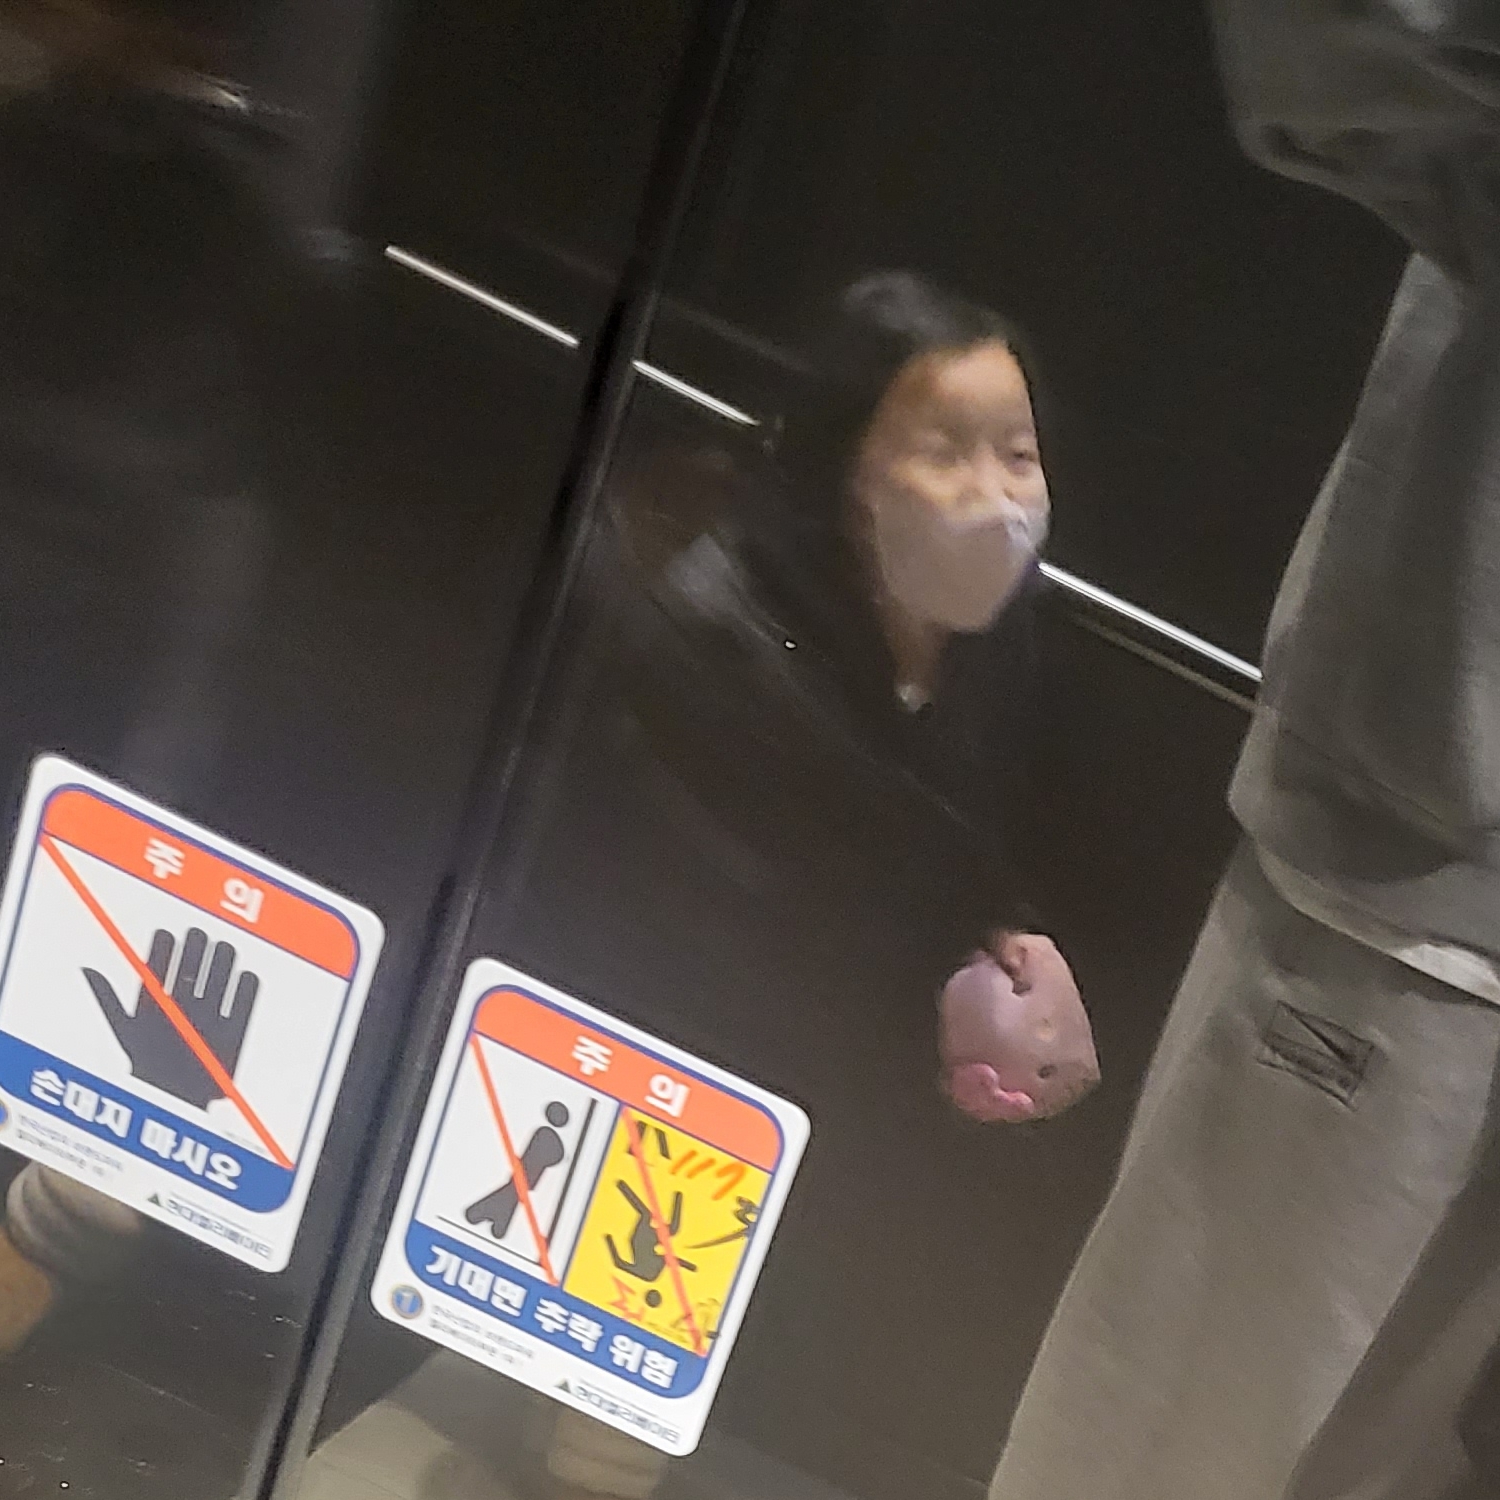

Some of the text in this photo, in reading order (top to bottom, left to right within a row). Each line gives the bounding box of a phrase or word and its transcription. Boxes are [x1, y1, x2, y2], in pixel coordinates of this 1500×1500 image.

[144, 837, 265, 924] 주 의
[30, 1066, 132, 1140] 손대지
[141, 1116, 244, 1192] 마시오
[571, 1035, 690, 1118] 주 의
[425, 1243, 528, 1319] 기대면
[535, 1297, 604, 1353] 추락
[610, 1334, 679, 1390] 위험
